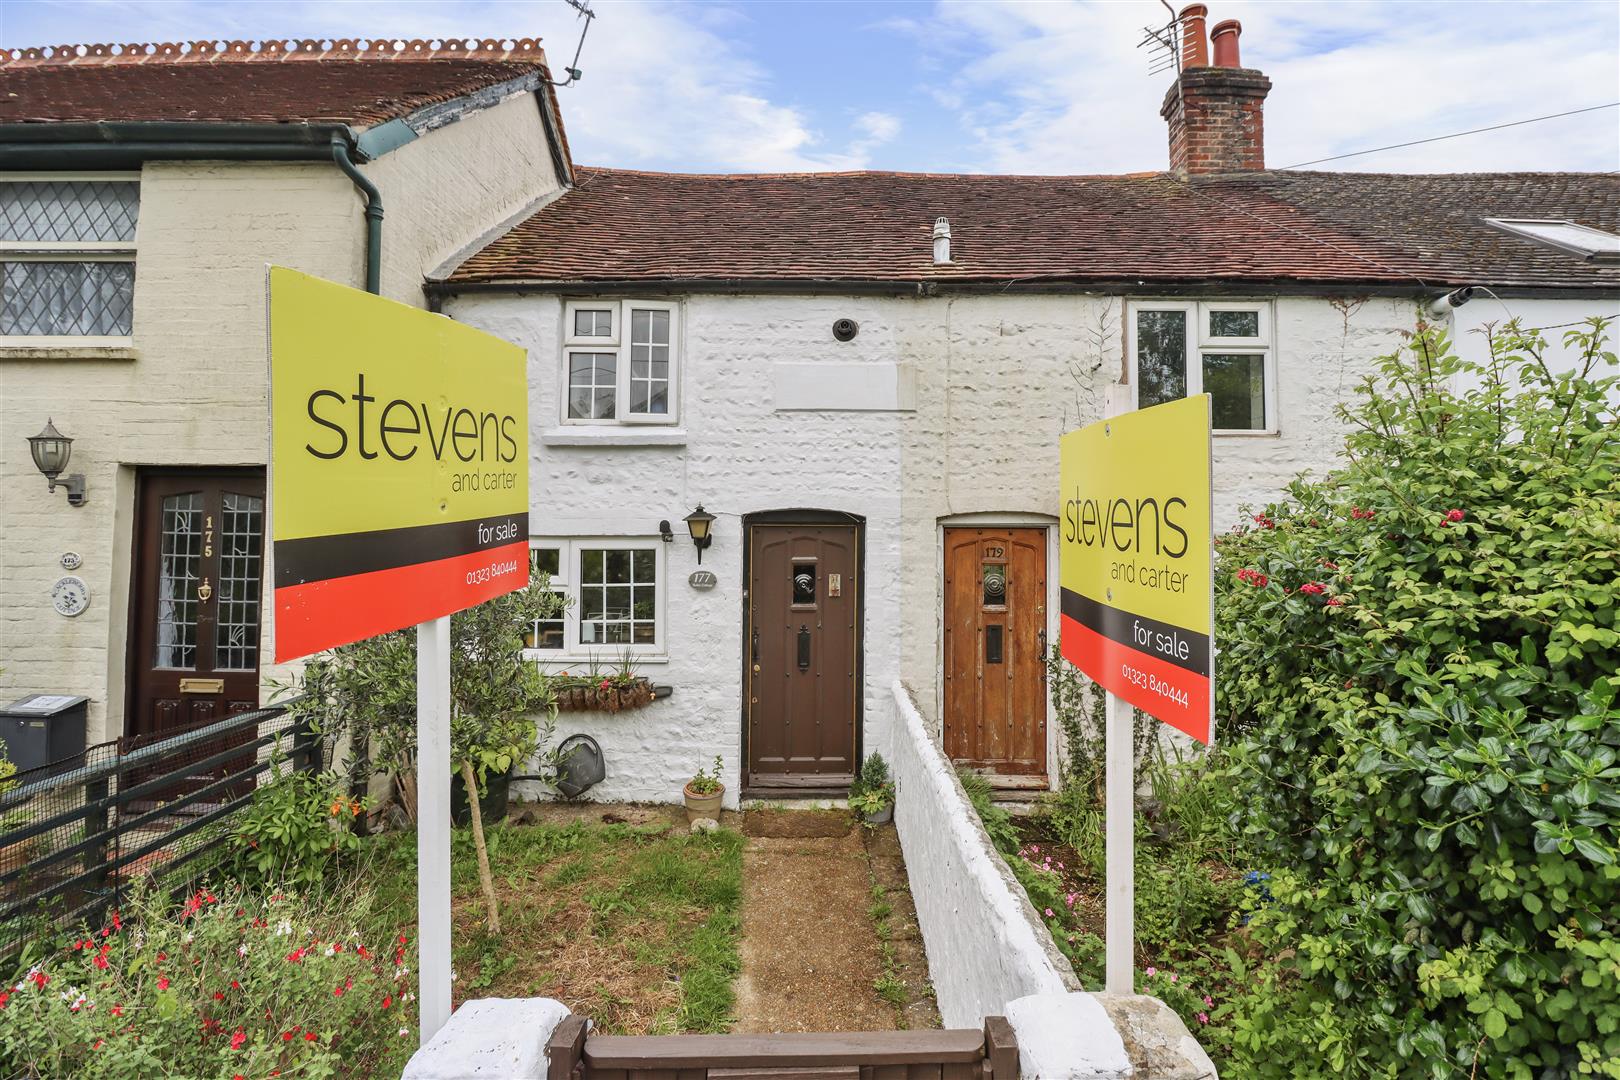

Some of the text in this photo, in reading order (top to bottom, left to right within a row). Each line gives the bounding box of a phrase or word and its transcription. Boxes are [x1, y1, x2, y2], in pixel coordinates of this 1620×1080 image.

[305, 373, 518, 463] stevens
[452, 468, 518, 493] and carter
[204, 515, 213, 558] 175
[478, 519, 518, 545] for sale
[1065, 485, 1189, 559] stevens
[985, 547, 1004, 558] 179
[466, 560, 518, 585] 01323 840444
[694, 573, 711, 583] 177
[1111, 559, 1189, 594] and carter
[1133, 620, 1190, 661] for sale
[1122, 664, 1189, 710] 01323 840444
